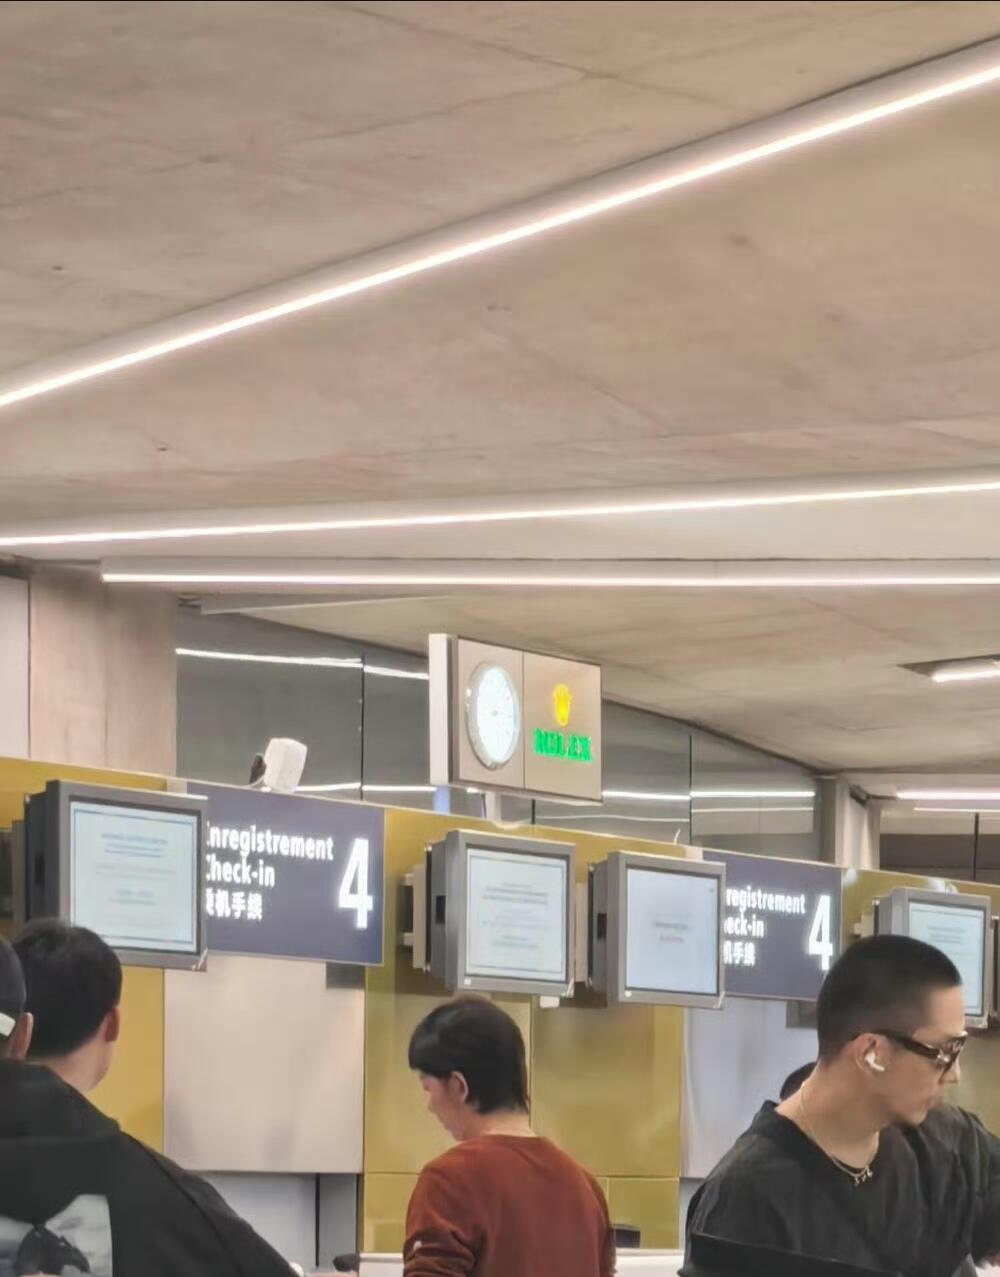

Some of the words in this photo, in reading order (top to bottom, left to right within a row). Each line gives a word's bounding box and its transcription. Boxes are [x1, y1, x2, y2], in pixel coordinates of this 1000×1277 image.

[206, 820, 334, 861] nregistrement
[338, 837, 374, 929] 4
[723, 911, 764, 938] eck-in
[808, 894, 833, 971] 4
